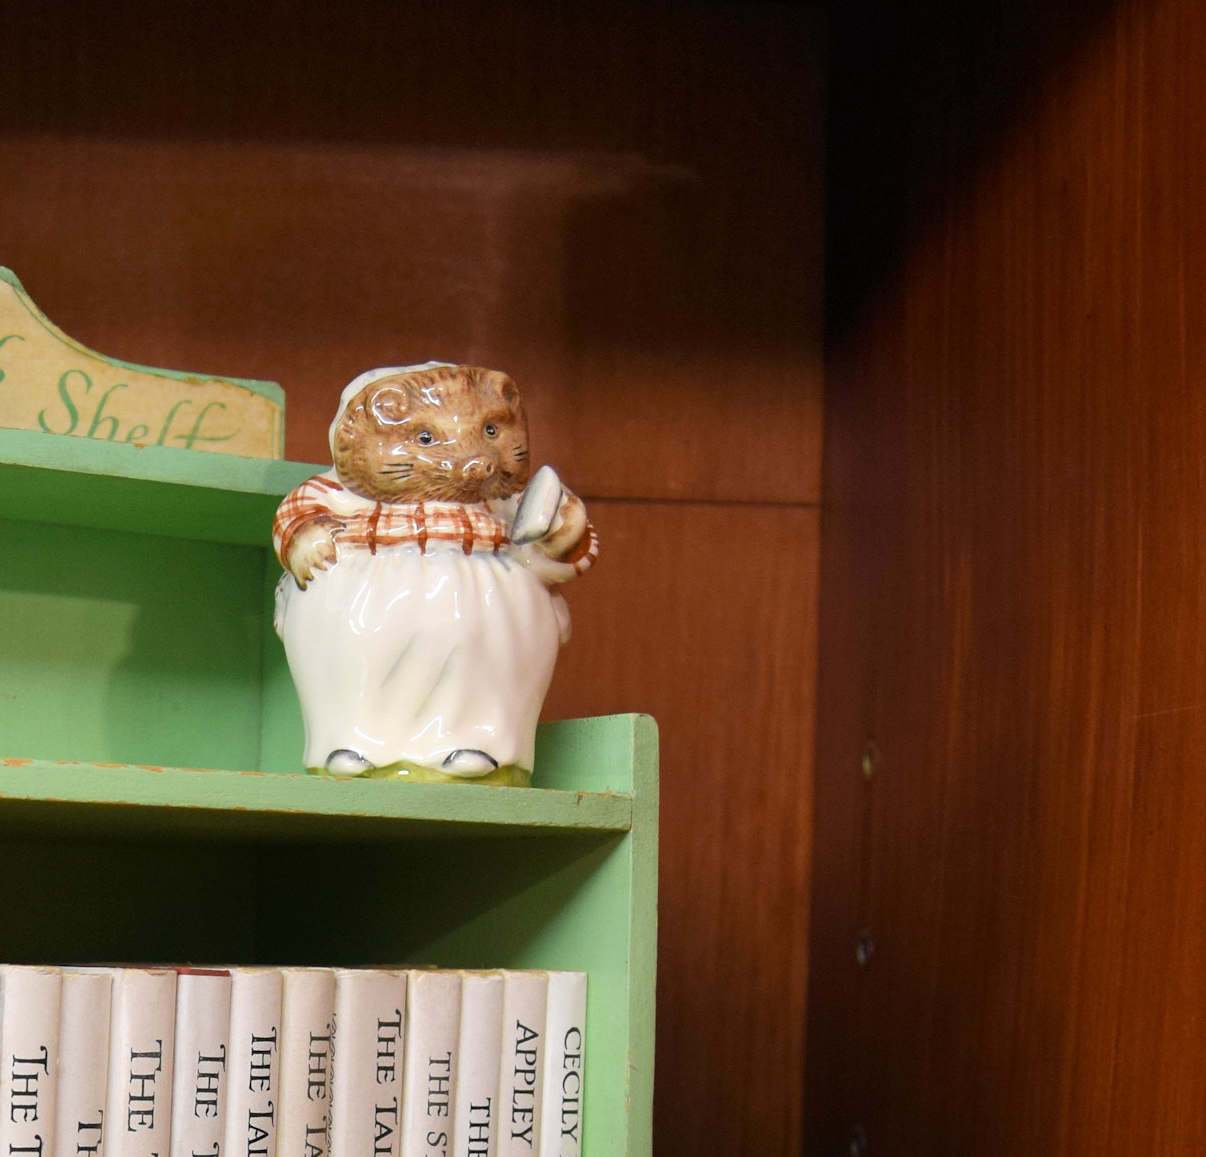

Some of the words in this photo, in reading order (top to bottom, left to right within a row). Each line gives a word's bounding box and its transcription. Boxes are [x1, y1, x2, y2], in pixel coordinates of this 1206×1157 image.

[39, 369, 241, 450] Shelf
[11, 1046, 49, 1123] THE
[195, 1044, 226, 1117] THE
[249, 1027, 277, 1092] THE
[307, 1023, 332, 1102] THE
[377, 1009, 402, 1084] THE
[427, 1052, 452, 1117] THE
[511, 1020, 539, 1148] APPLEY
[561, 1027, 581, 1143] CECILY
[128, 1040, 162, 1132] THE
